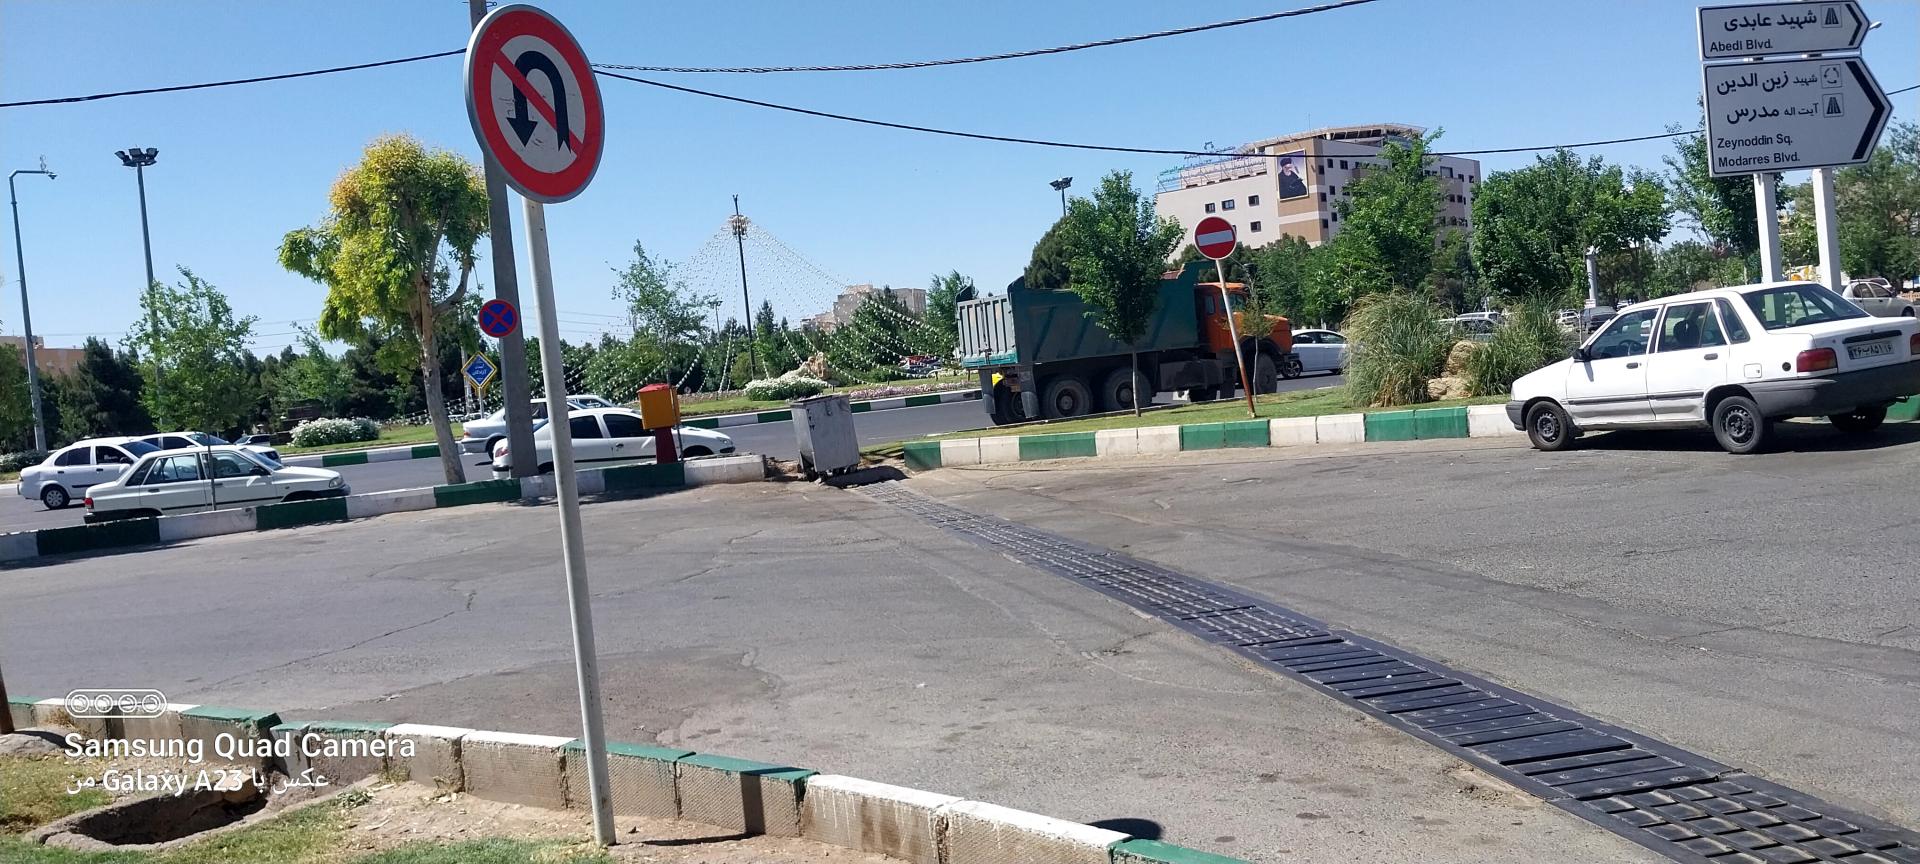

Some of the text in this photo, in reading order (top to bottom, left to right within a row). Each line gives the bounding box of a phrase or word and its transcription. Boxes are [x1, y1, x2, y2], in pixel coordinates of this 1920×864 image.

[1724, 10, 1817, 32] شهید عابدی
[1709, 38, 1773, 52] Abedi Blvd.
[1716, 71, 1818, 96] شهید زین الدین
[1726, 107, 1780, 124] مدرس
[1717, 133, 1793, 149] Zeynoddin Sq.
[1718, 152, 1800, 167] Modarres Blvd.
